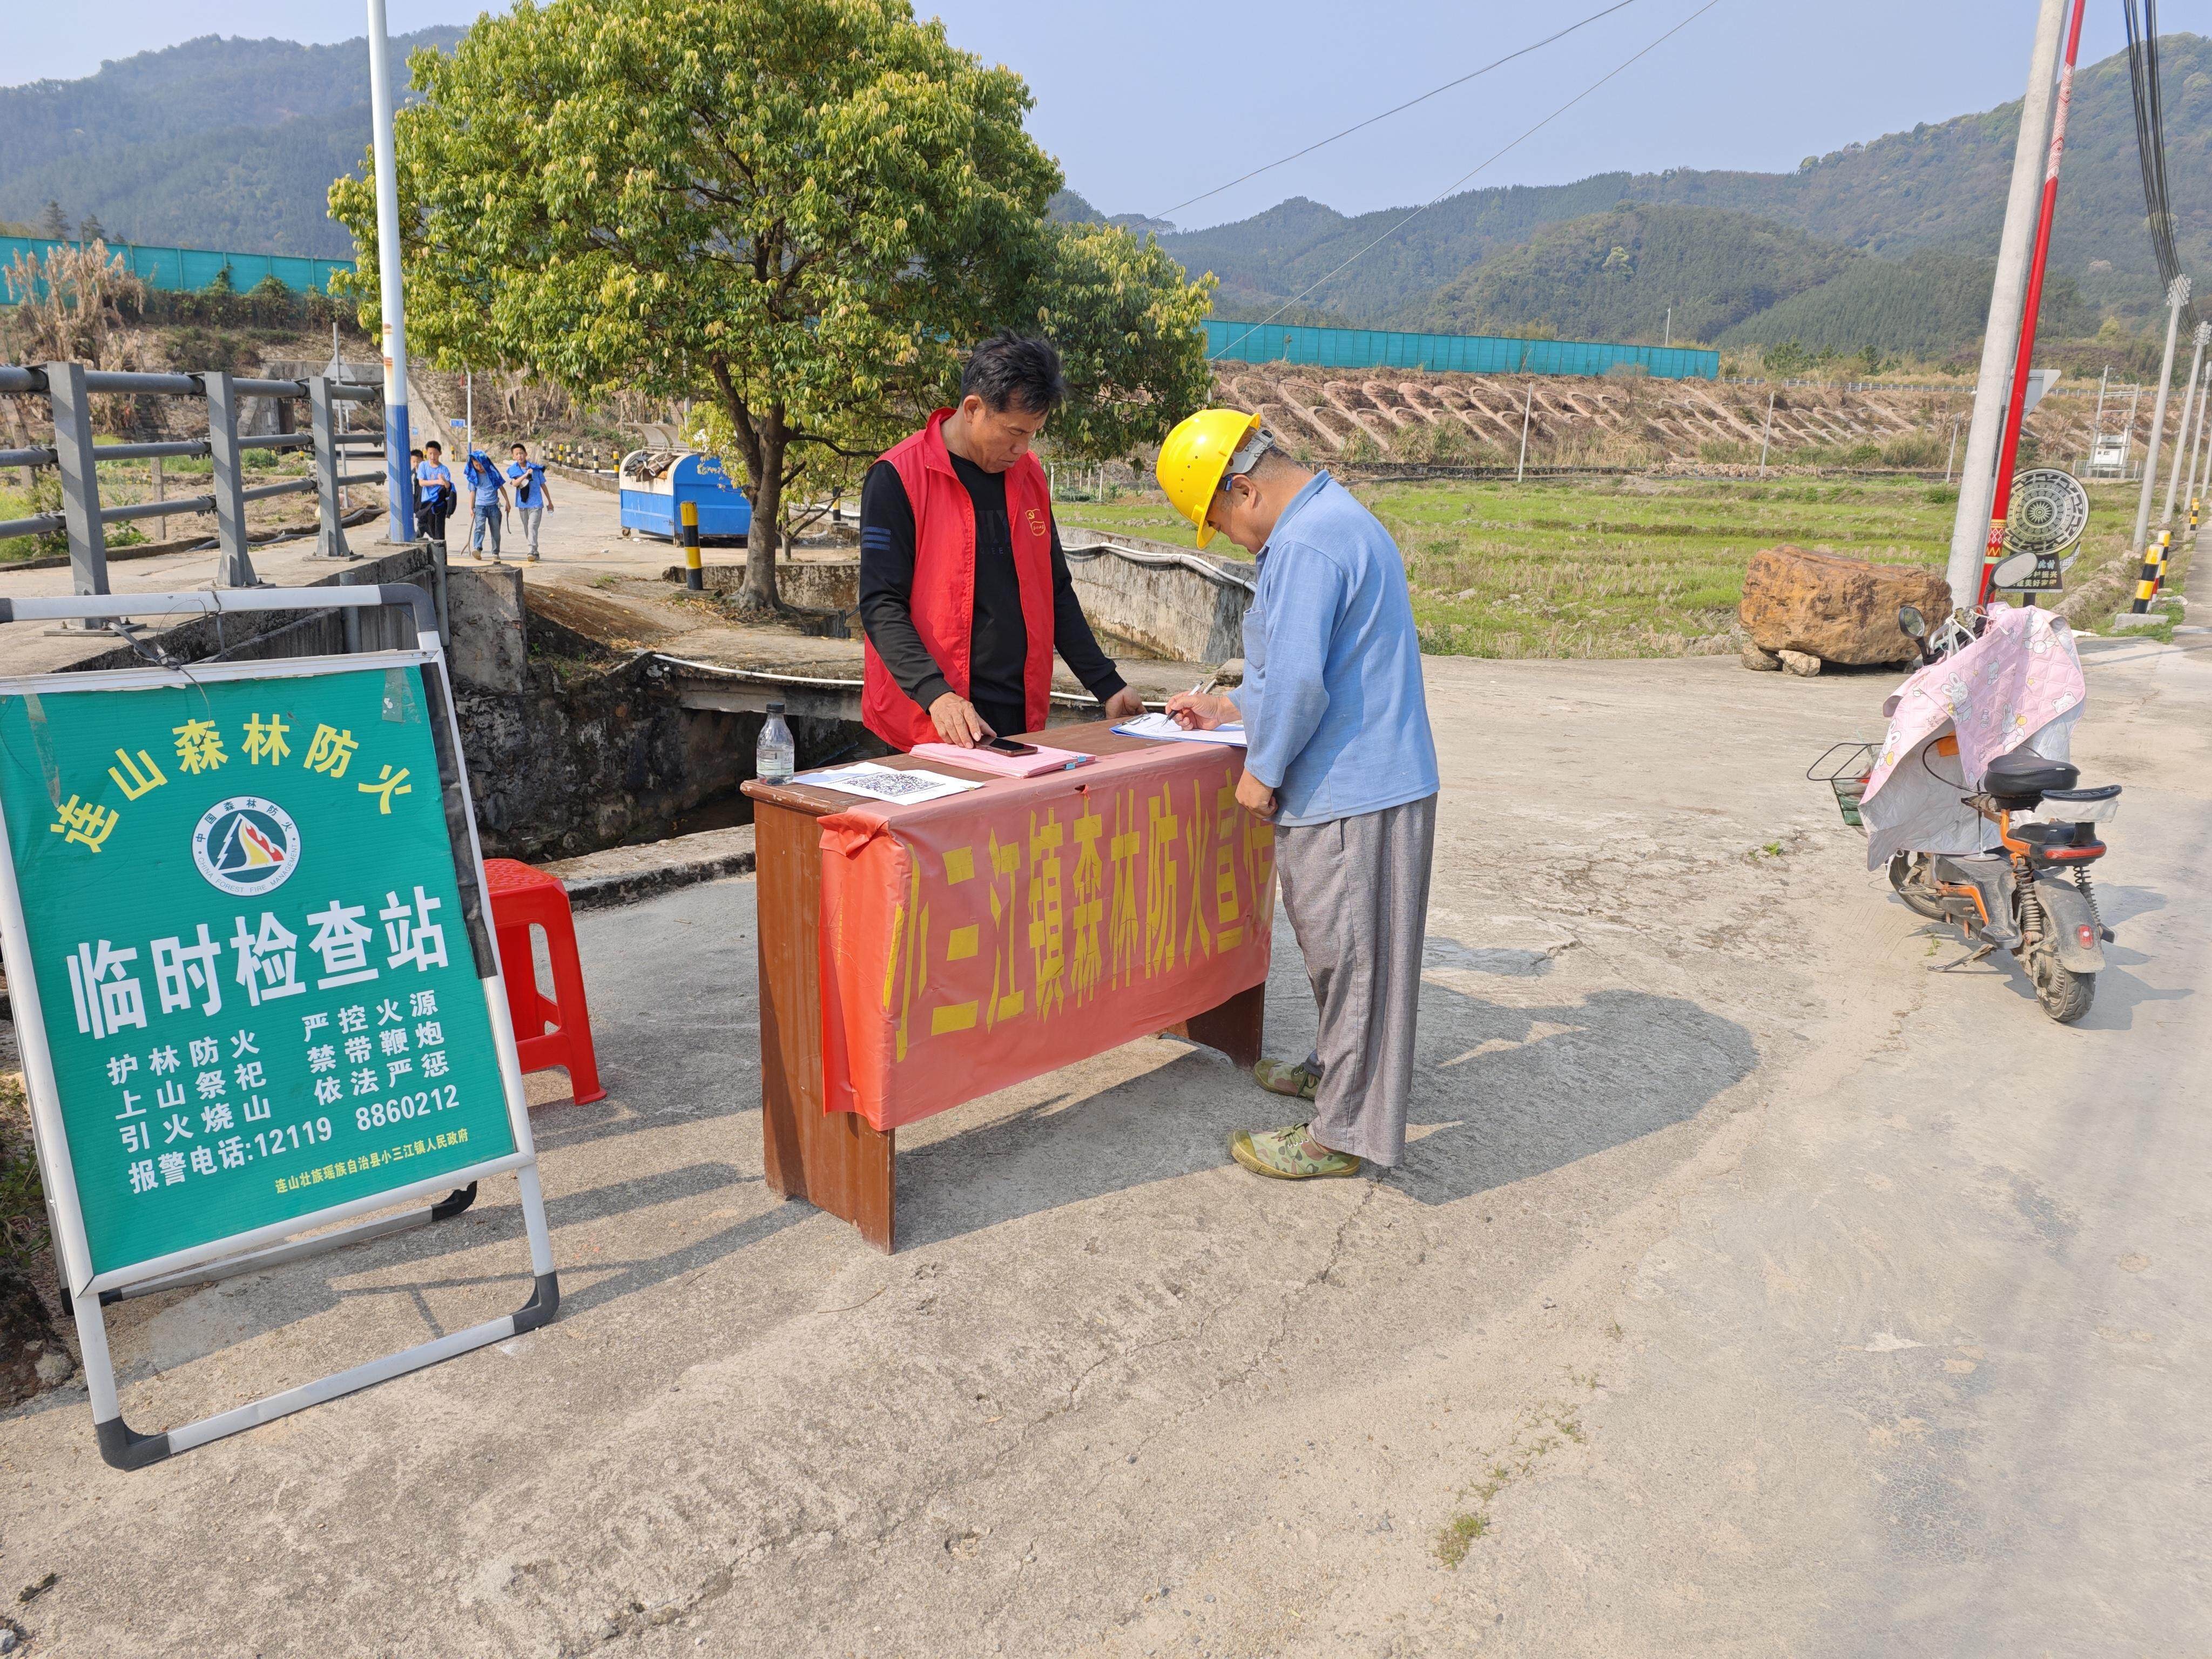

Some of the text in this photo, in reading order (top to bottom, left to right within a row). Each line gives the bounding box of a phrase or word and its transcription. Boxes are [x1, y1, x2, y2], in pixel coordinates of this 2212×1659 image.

[50, 713, 412, 853] 连山森林防火
[195, 798, 293, 842] 中国森林防火
[198, 844, 298, 893] CHINA FOREST FIRE MANAGEMENT
[66, 886, 449, 1040] 临时检查站
[106, 989, 439, 1085] 护林防火 严控火源
[115, 1021, 444, 1120] 上山祭祀 禁带鞭炮
[119, 1050, 450, 1153] 引火烧山 依法严惩
[355, 1084, 460, 1131] 8860212
[275, 1128, 469, 1194] 连山壮族瑶族自治县小三江镇人民政府
